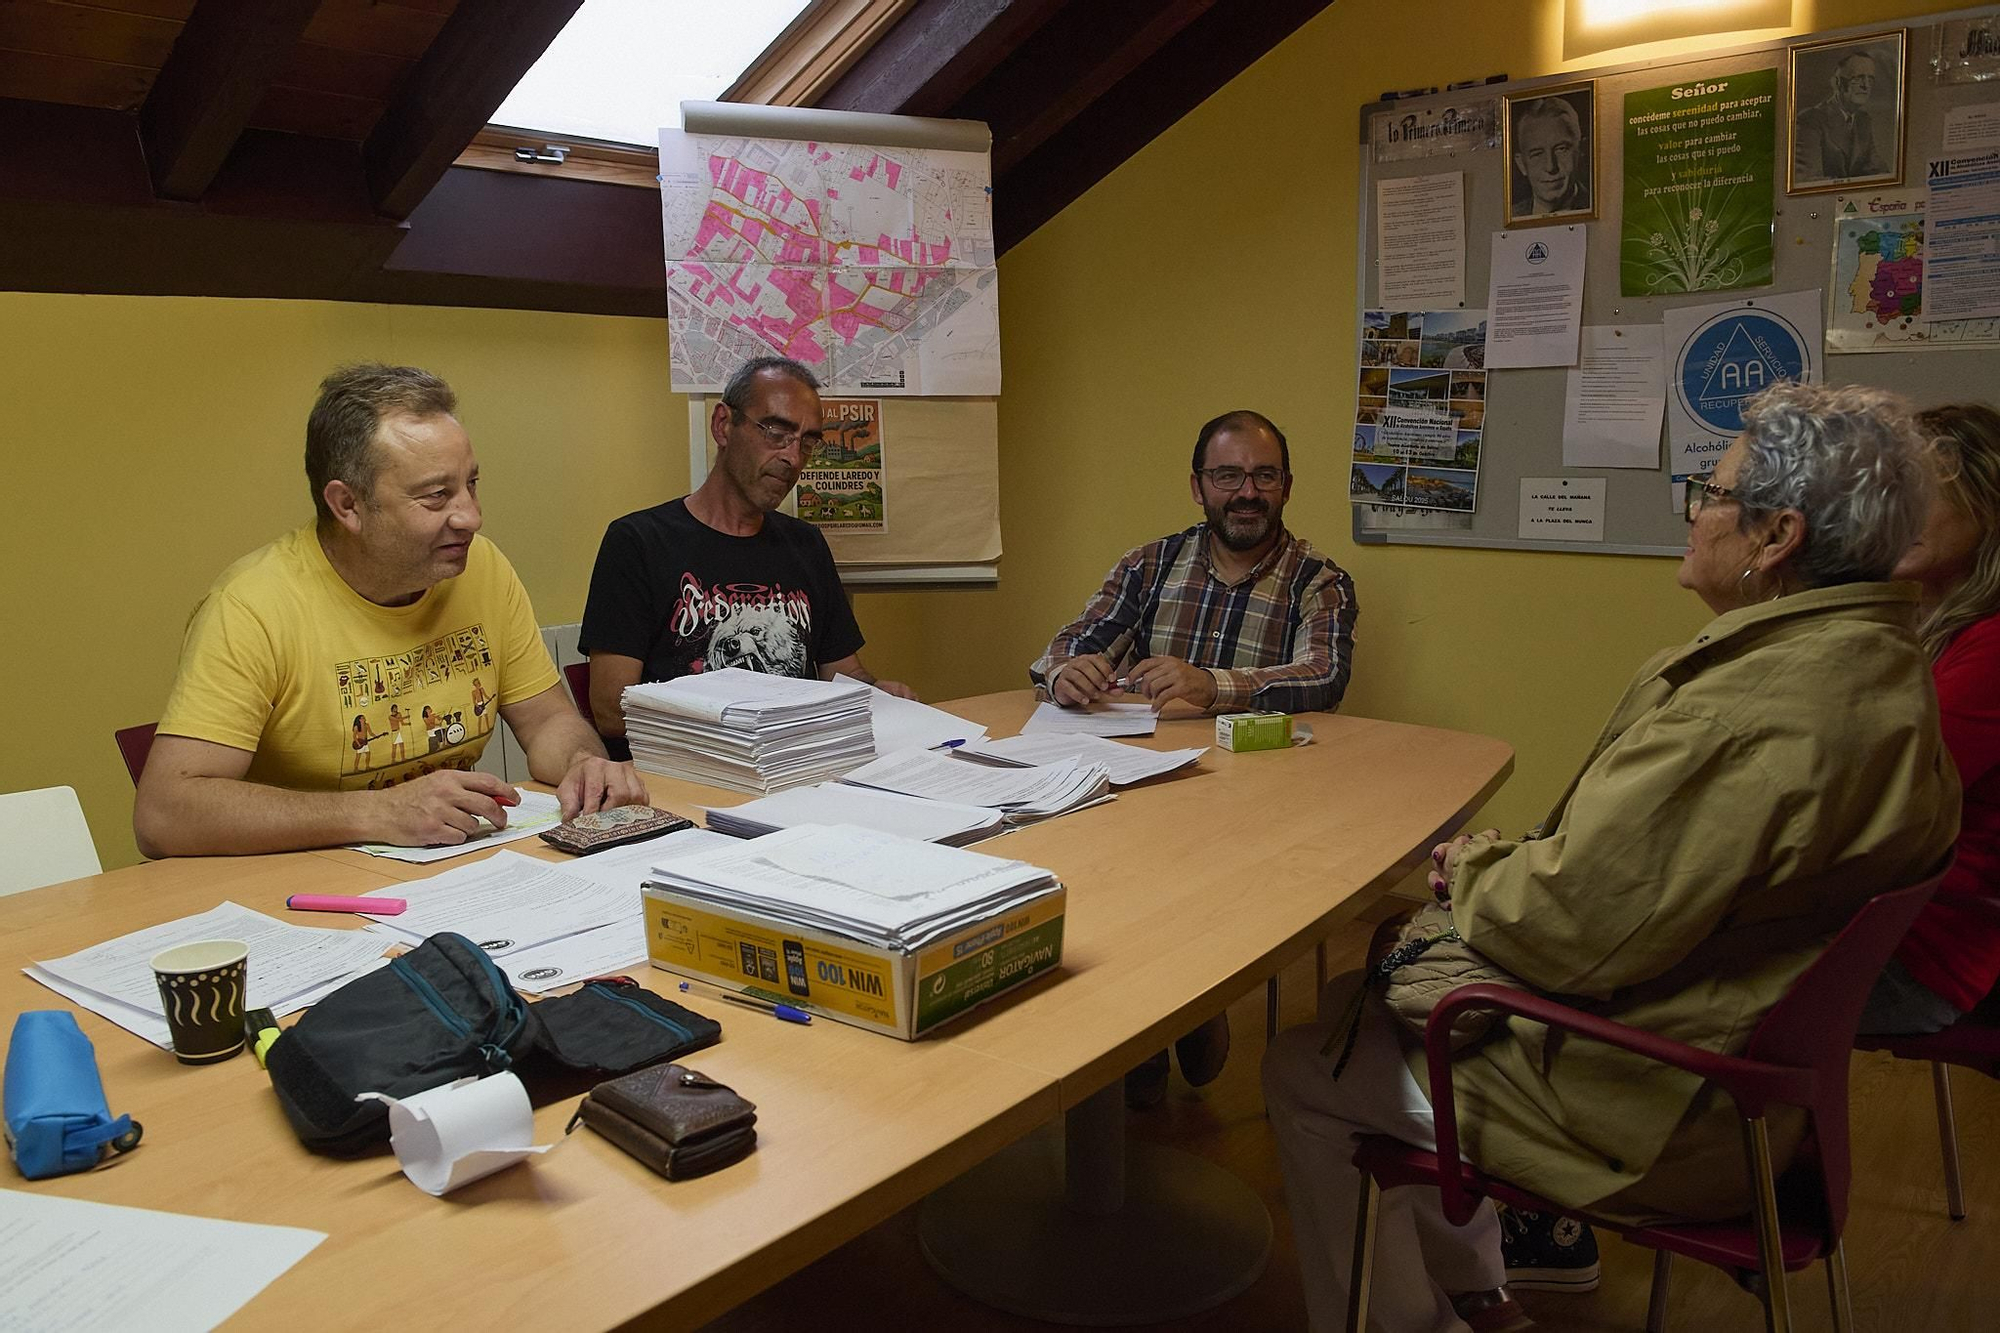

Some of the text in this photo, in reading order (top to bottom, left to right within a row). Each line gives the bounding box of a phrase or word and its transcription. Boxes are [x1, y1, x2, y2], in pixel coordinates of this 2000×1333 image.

[1671, 81, 1728, 100] Señor
[1672, 101, 1719, 118] serenidad
[1720, 98, 1739, 112] para
[1740, 94, 1772, 108] aceptar
[1637, 126, 1648, 136] las
[1650, 124, 1671, 134] cosas
[1672, 120, 1687, 133] que
[1688, 119, 1698, 128] no
[1700, 113, 1725, 128] puedo
[1658, 131, 1737, 150] valor para cambiar
[1656, 154, 1668, 164] las
[1669, 151, 1690, 162] cosas
[1691, 148, 1706, 160] que
[1716, 143, 1741, 157] puedo
[1671, 171, 1676, 181] y
[1929, 161, 1949, 178] XII
[1643, 173, 1754, 198] para reconocer la diferencia
[1868, 197, 1907, 215] España
[1701, 341, 1726, 381] UNIDAD
[1754, 335, 1788, 379] SERVICIO
[1721, 359, 1764, 390] AA
[826, 408, 839, 419] AL
[839, 404, 875, 422] PSIR
[1382, 415, 1397, 428] XII
[1700, 458, 1720, 470] gru
[800, 471, 880, 481] DEFIENDE LAREDO Y
[815, 481, 864, 491] COLINDRES
[671, 572, 812, 638] Federation
[981, 949, 994, 968] 80
[1000, 944, 1053, 979] NAVIGATOR
[817, 960, 883, 997] WIN 100
